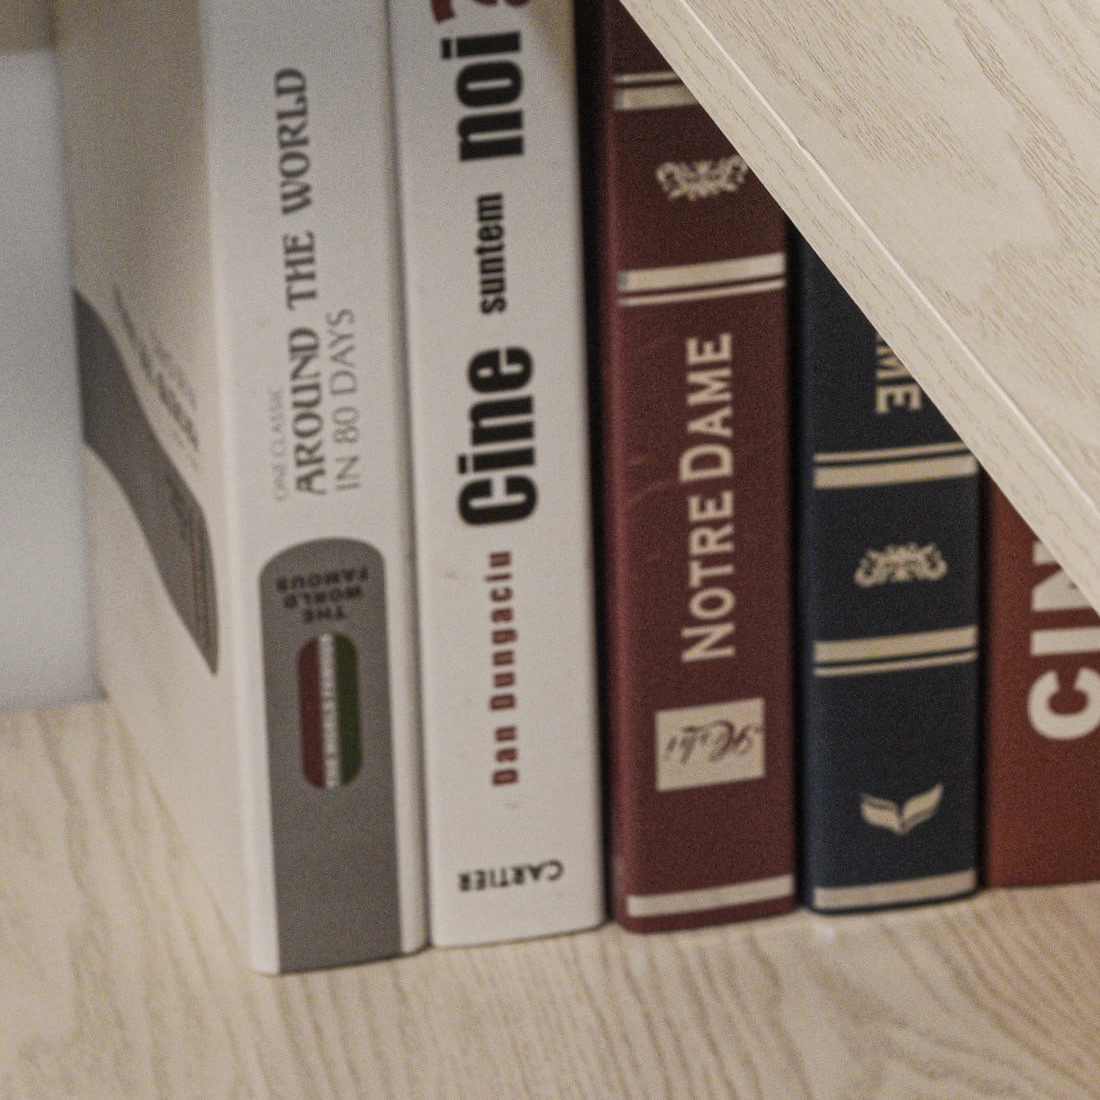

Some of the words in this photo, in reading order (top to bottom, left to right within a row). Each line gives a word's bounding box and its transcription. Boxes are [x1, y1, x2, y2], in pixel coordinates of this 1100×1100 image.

[274, 66, 312, 217] WORLD
[283, 231, 319, 310] THE
[474, 192, 507, 316] suntem
[325, 308, 358, 396] DAYS
[875, 331, 922, 415] ME
[287, 326, 328, 496] AROUND
[331, 405, 360, 444] 80
[456, 345, 538, 527] Cine
[678, 331, 734, 483] DAME
[335, 455, 361, 492] IN
[680, 489, 736, 664] NOTRE
[485, 551, 518, 712] Dungaciu
[491, 726, 519, 787] Dan
[457, 859, 565, 893] CARTIER
